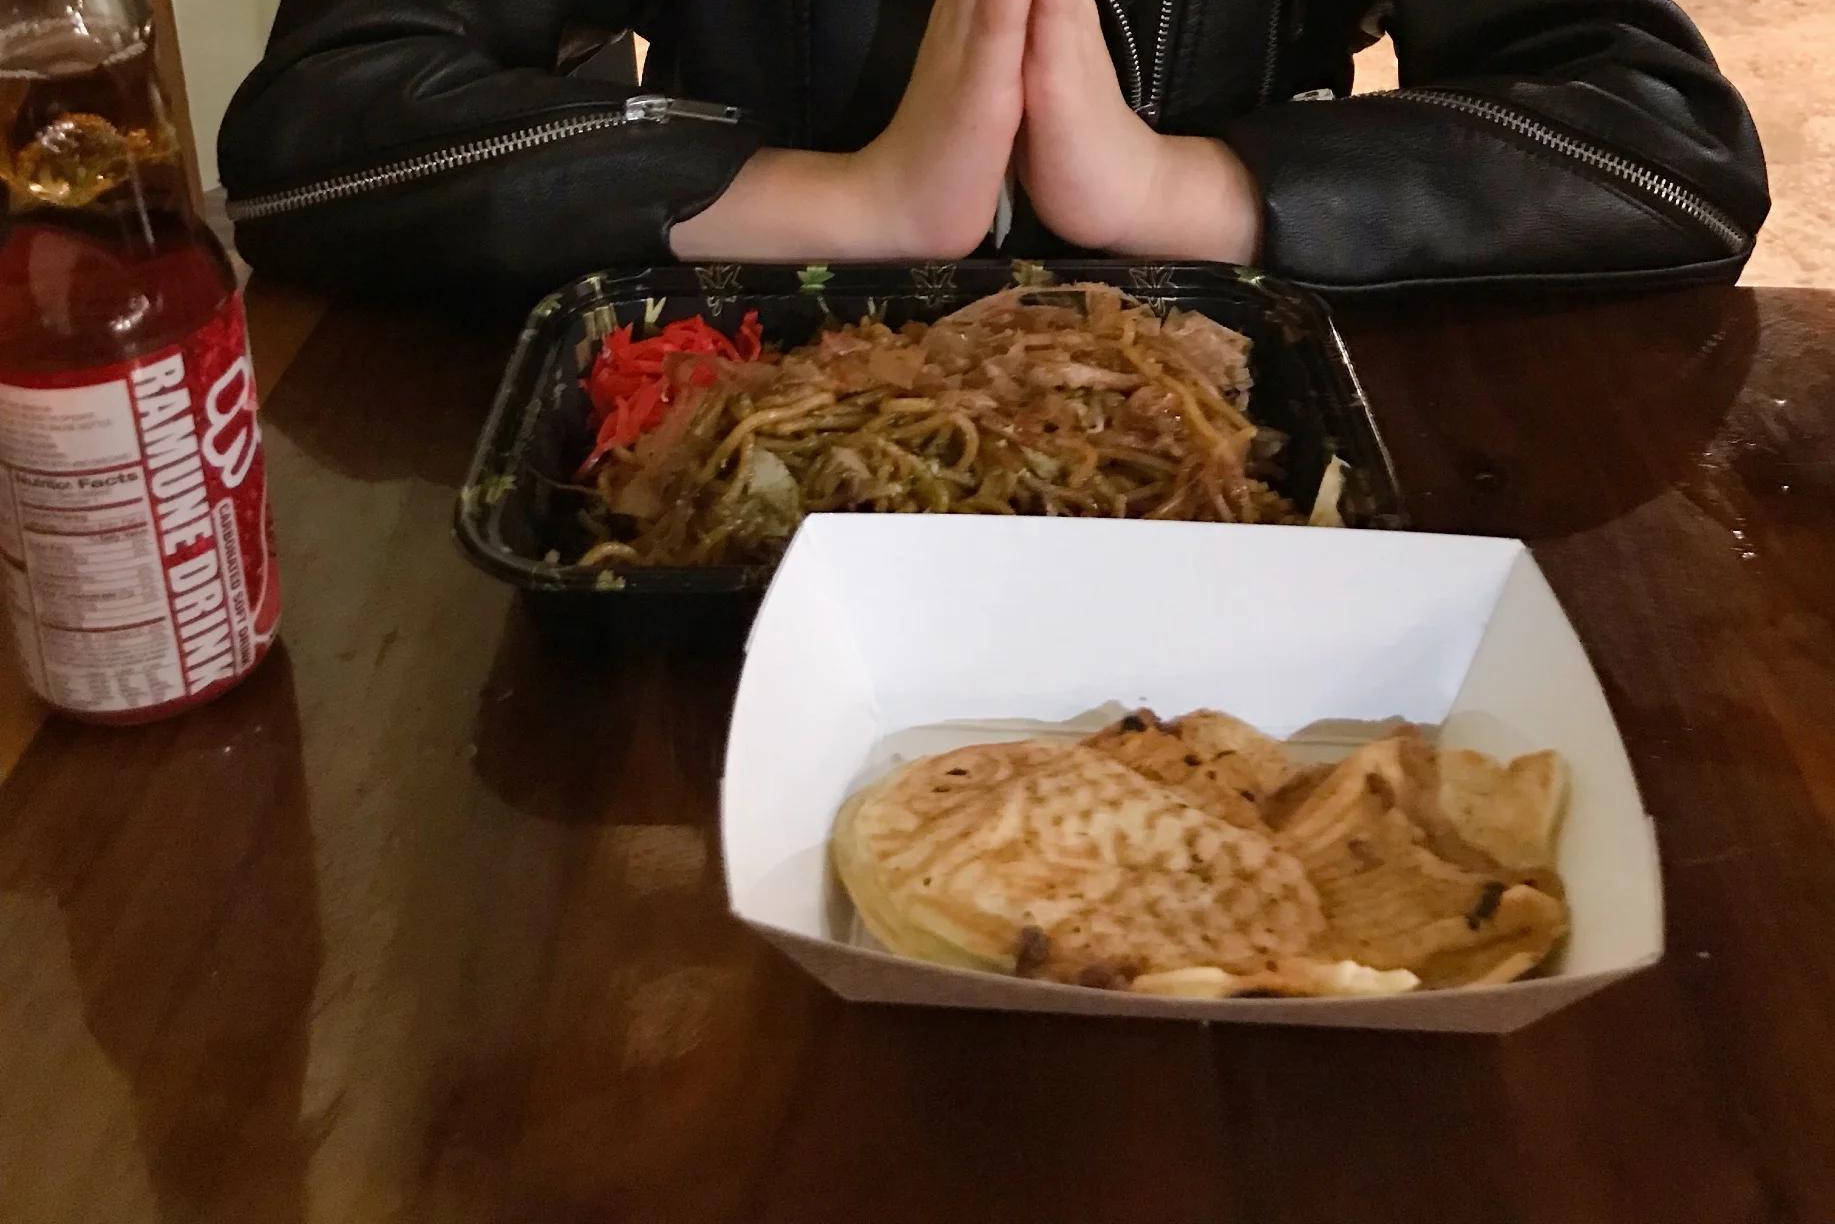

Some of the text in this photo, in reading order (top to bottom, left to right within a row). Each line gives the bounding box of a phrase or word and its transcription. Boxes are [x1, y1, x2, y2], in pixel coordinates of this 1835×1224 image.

[78, 472, 138, 488] Facts
[131, 353, 235, 695] RAMUNE DRINK
[219, 503, 252, 665] CARBONATED SOFT DRINK
